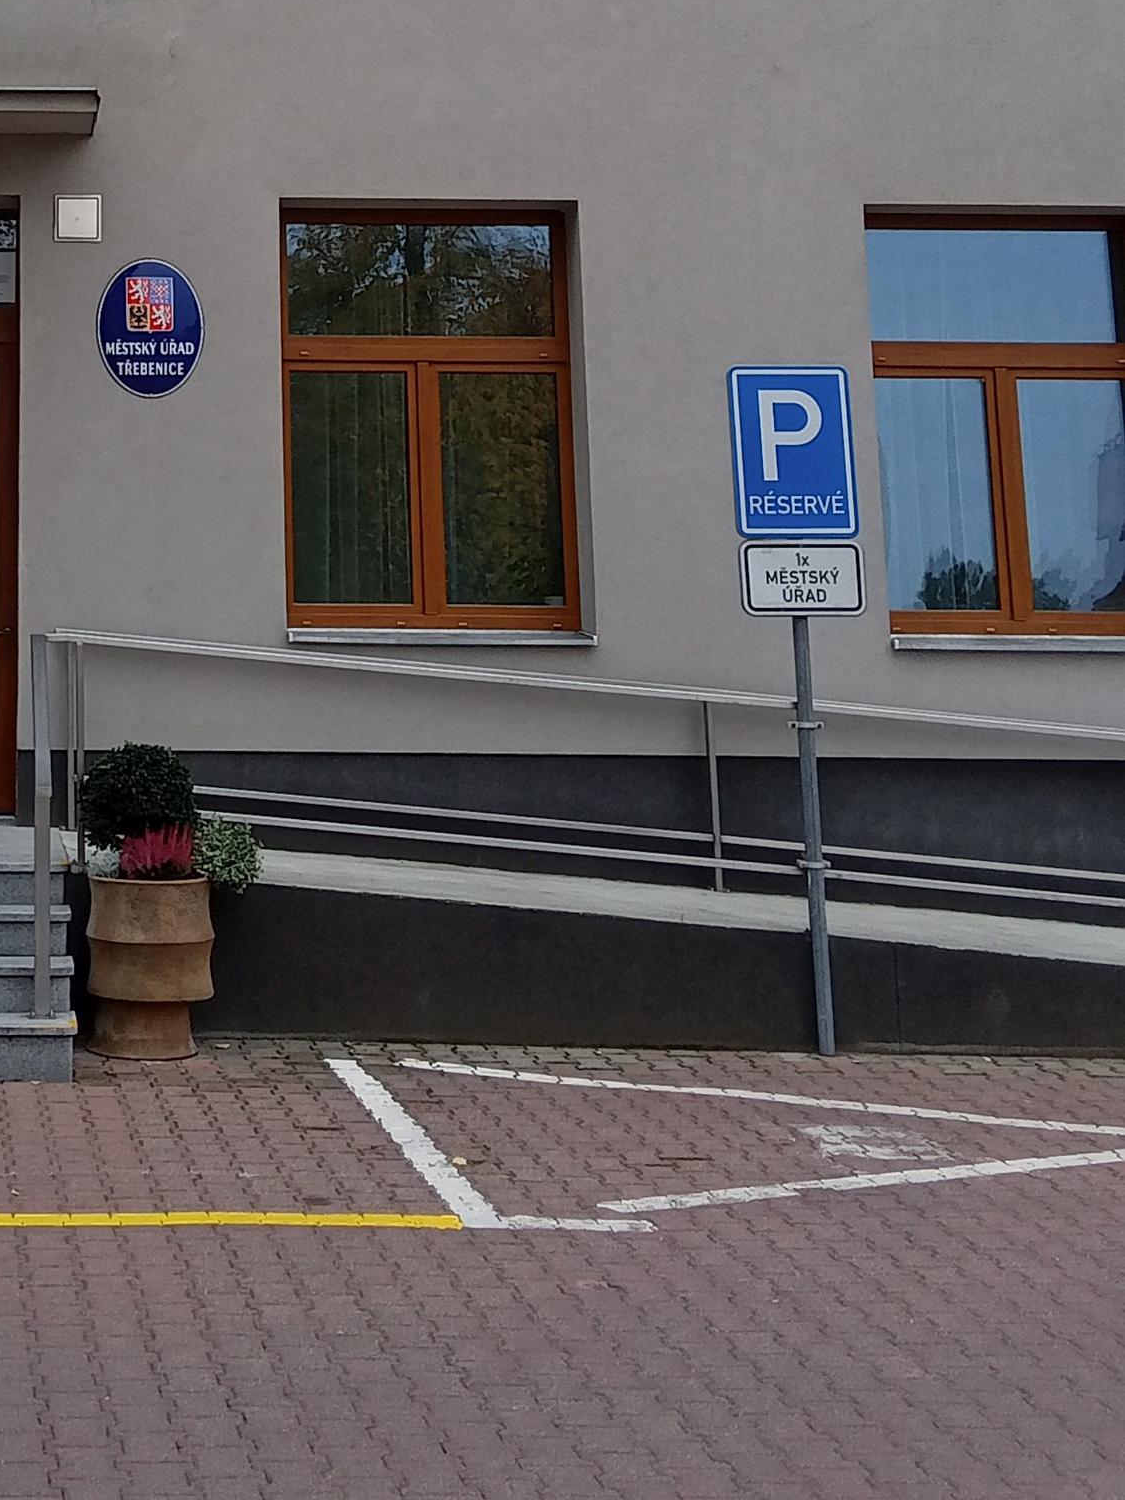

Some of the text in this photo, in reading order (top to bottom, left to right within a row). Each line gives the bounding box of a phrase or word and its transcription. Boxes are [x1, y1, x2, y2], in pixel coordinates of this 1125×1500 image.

[105, 338, 195, 355] MĚSTSKÝ ÚŘAD
[117, 359, 185, 376] TŘEBENICE
[757, 389, 822, 481] P
[749, 490, 846, 516] RÉSERVÉ
[795, 552, 810, 567] 1x
[765, 566, 840, 585] MĚSTSKÝ
[782, 585, 827, 604] ÚŘAD
